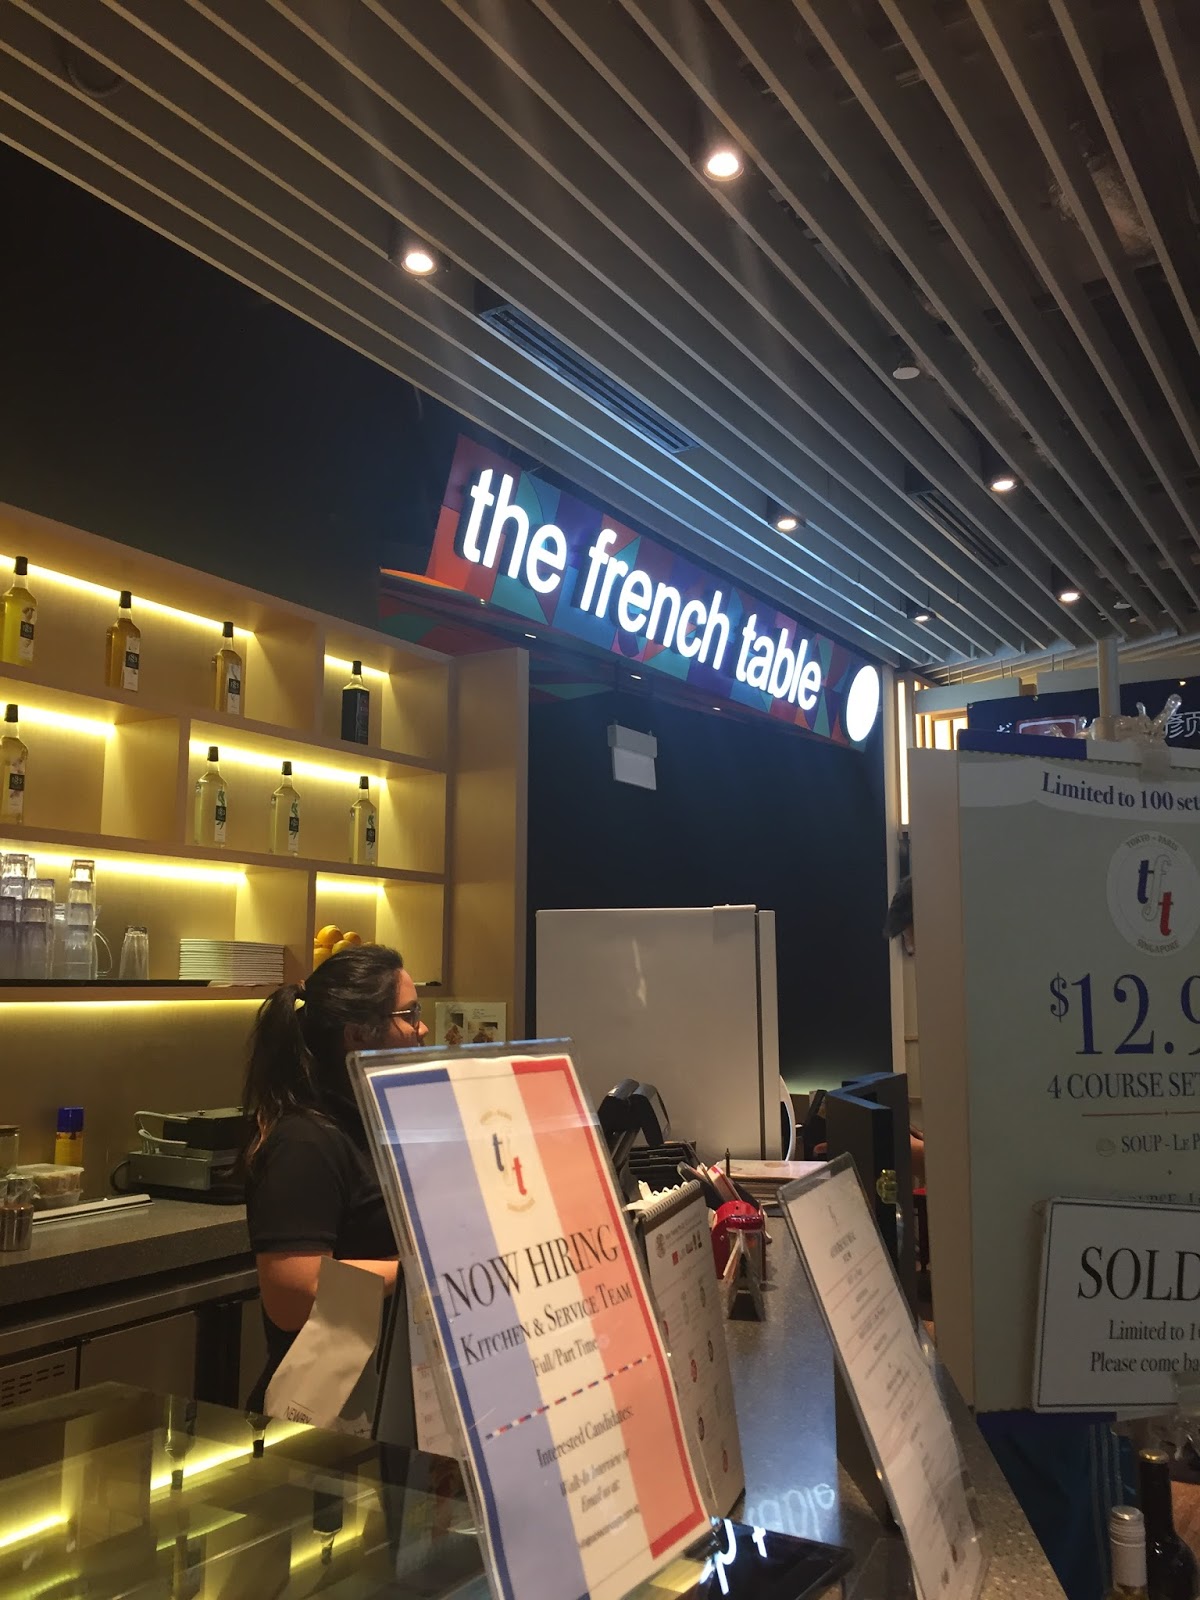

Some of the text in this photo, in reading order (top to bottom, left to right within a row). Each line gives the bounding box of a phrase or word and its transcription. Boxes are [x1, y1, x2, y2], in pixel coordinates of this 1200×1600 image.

[460, 468, 823, 711] the french table
[1041, 771, 1114, 805] Limited
[1118, 794, 1136, 808] to
[1141, 790, 1174, 810] 100
[1047, 1074, 1062, 1099] 4
[1067, 1072, 1163, 1099] COURSE
[1121, 1134, 1162, 1153] SOUP
[442, 1224, 618, 1318] NOW HIRING
[1078, 1246, 1200, 1302] SOLD
[460, 1282, 633, 1366] KITCHEN & SERVICE TEAM
[1108, 1319, 1166, 1341] Limited
[1170, 1322, 1183, 1341] to
[1090, 1351, 1137, 1373] Please
[1140, 1356, 1180, 1373] come
[536, 1426, 585, 1469] Interested
